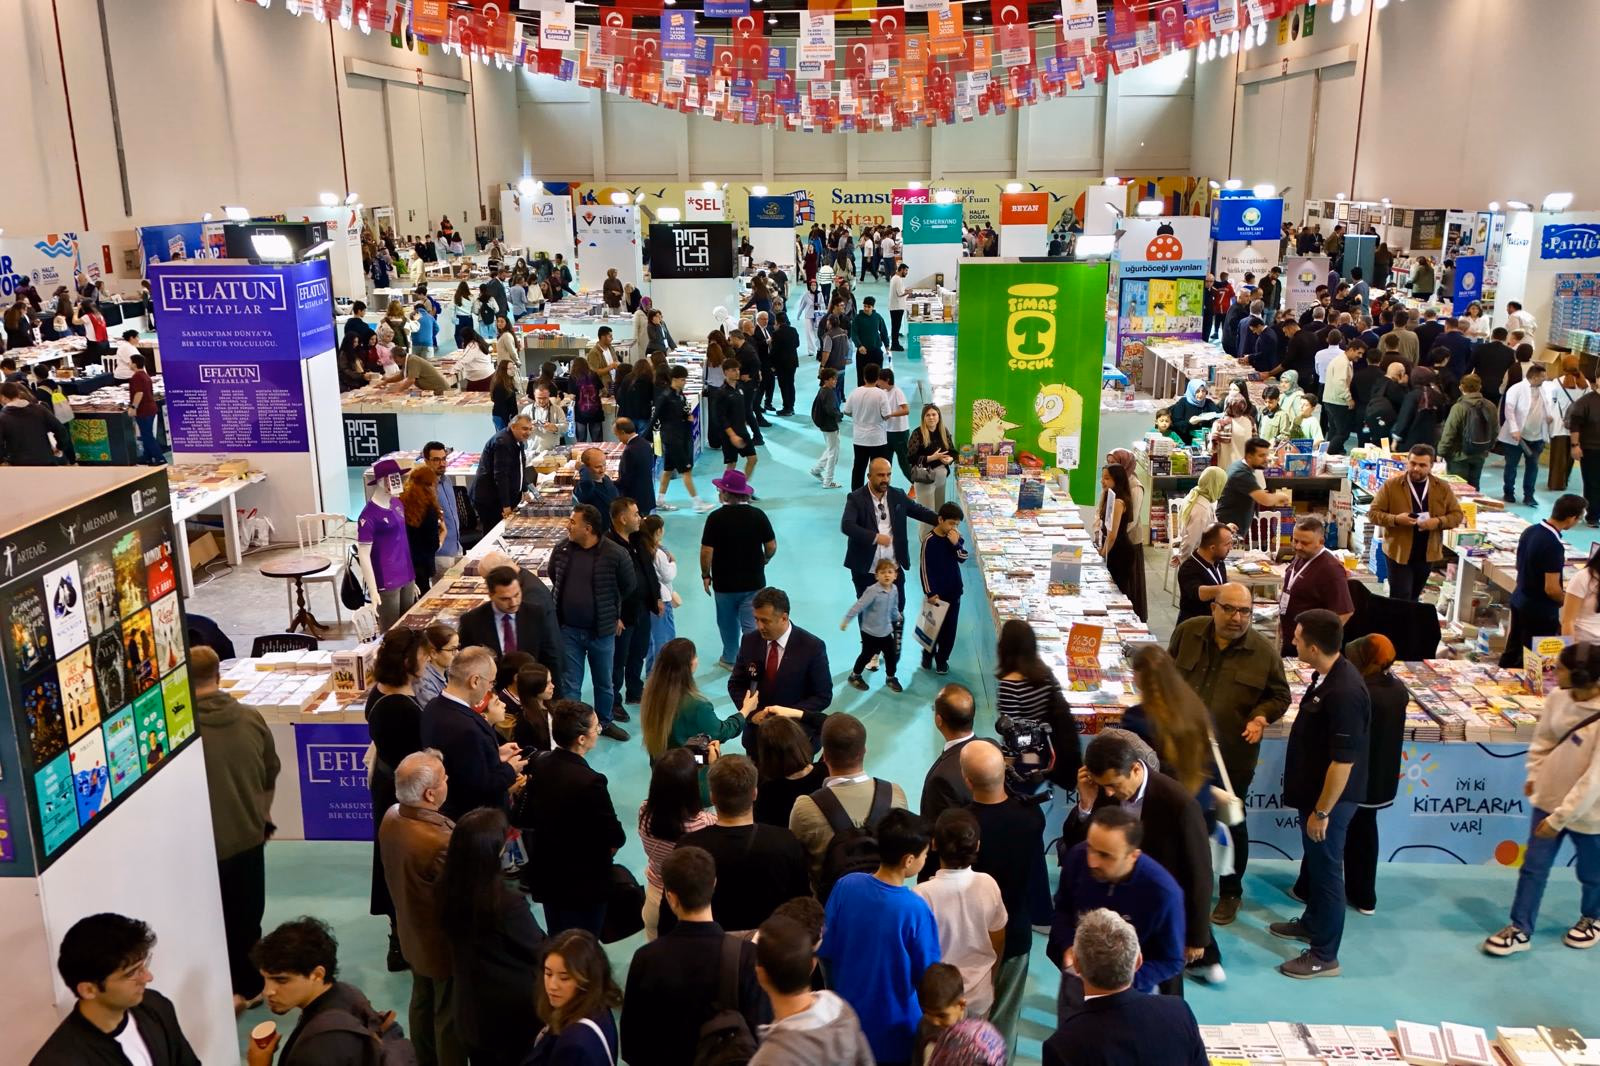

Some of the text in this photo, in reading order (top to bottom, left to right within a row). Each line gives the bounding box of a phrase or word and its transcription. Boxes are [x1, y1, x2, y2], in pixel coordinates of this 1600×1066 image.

[1011, 204, 1040, 212] BEYAN
[598, 215, 626, 225] TÜBİTAK
[1125, 263, 1202, 274] uğurböceği yayınları
[169, 281, 277, 300] EFLATUN
[299, 283, 327, 300] EFLATUN
[189, 303, 262, 315] KİTAPLAR
[1007, 358, 1055, 371] ÇOCUK
[204, 367, 256, 378] EFLATUN
[1072, 634, 1097, 648] %30
[318, 751, 370, 771] EFL
[339, 775, 370, 787] KİT
[1413, 794, 1524, 814] KİTAPLARIM
[1450, 817, 1483, 835] VAR!
